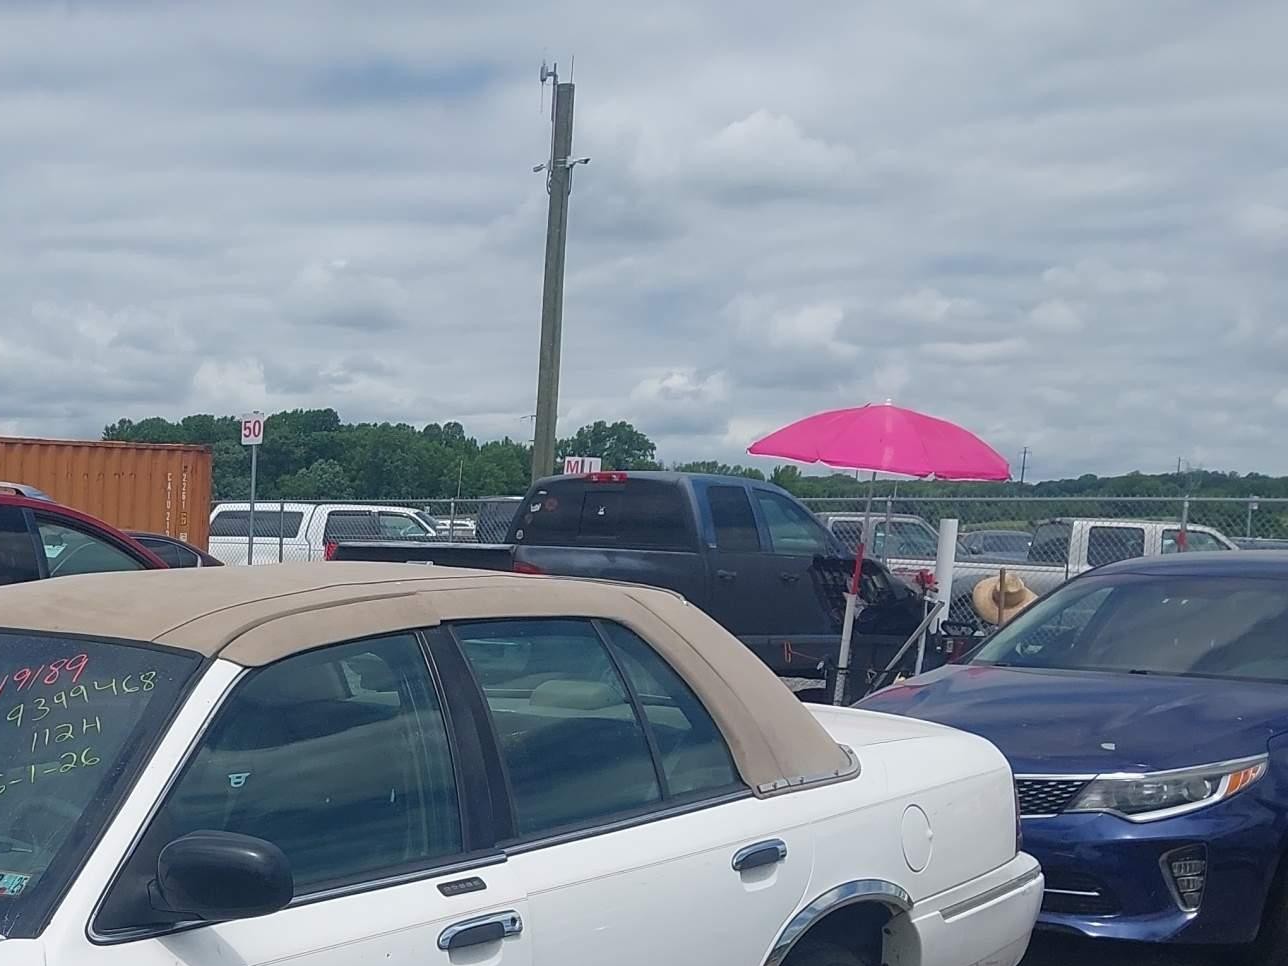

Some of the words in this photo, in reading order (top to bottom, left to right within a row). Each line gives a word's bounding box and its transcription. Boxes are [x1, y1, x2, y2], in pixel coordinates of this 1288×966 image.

[243, 420, 261, 438] 50
[7, 671, 157, 727] 9399468
[31, 716, 101, 753] 112H
